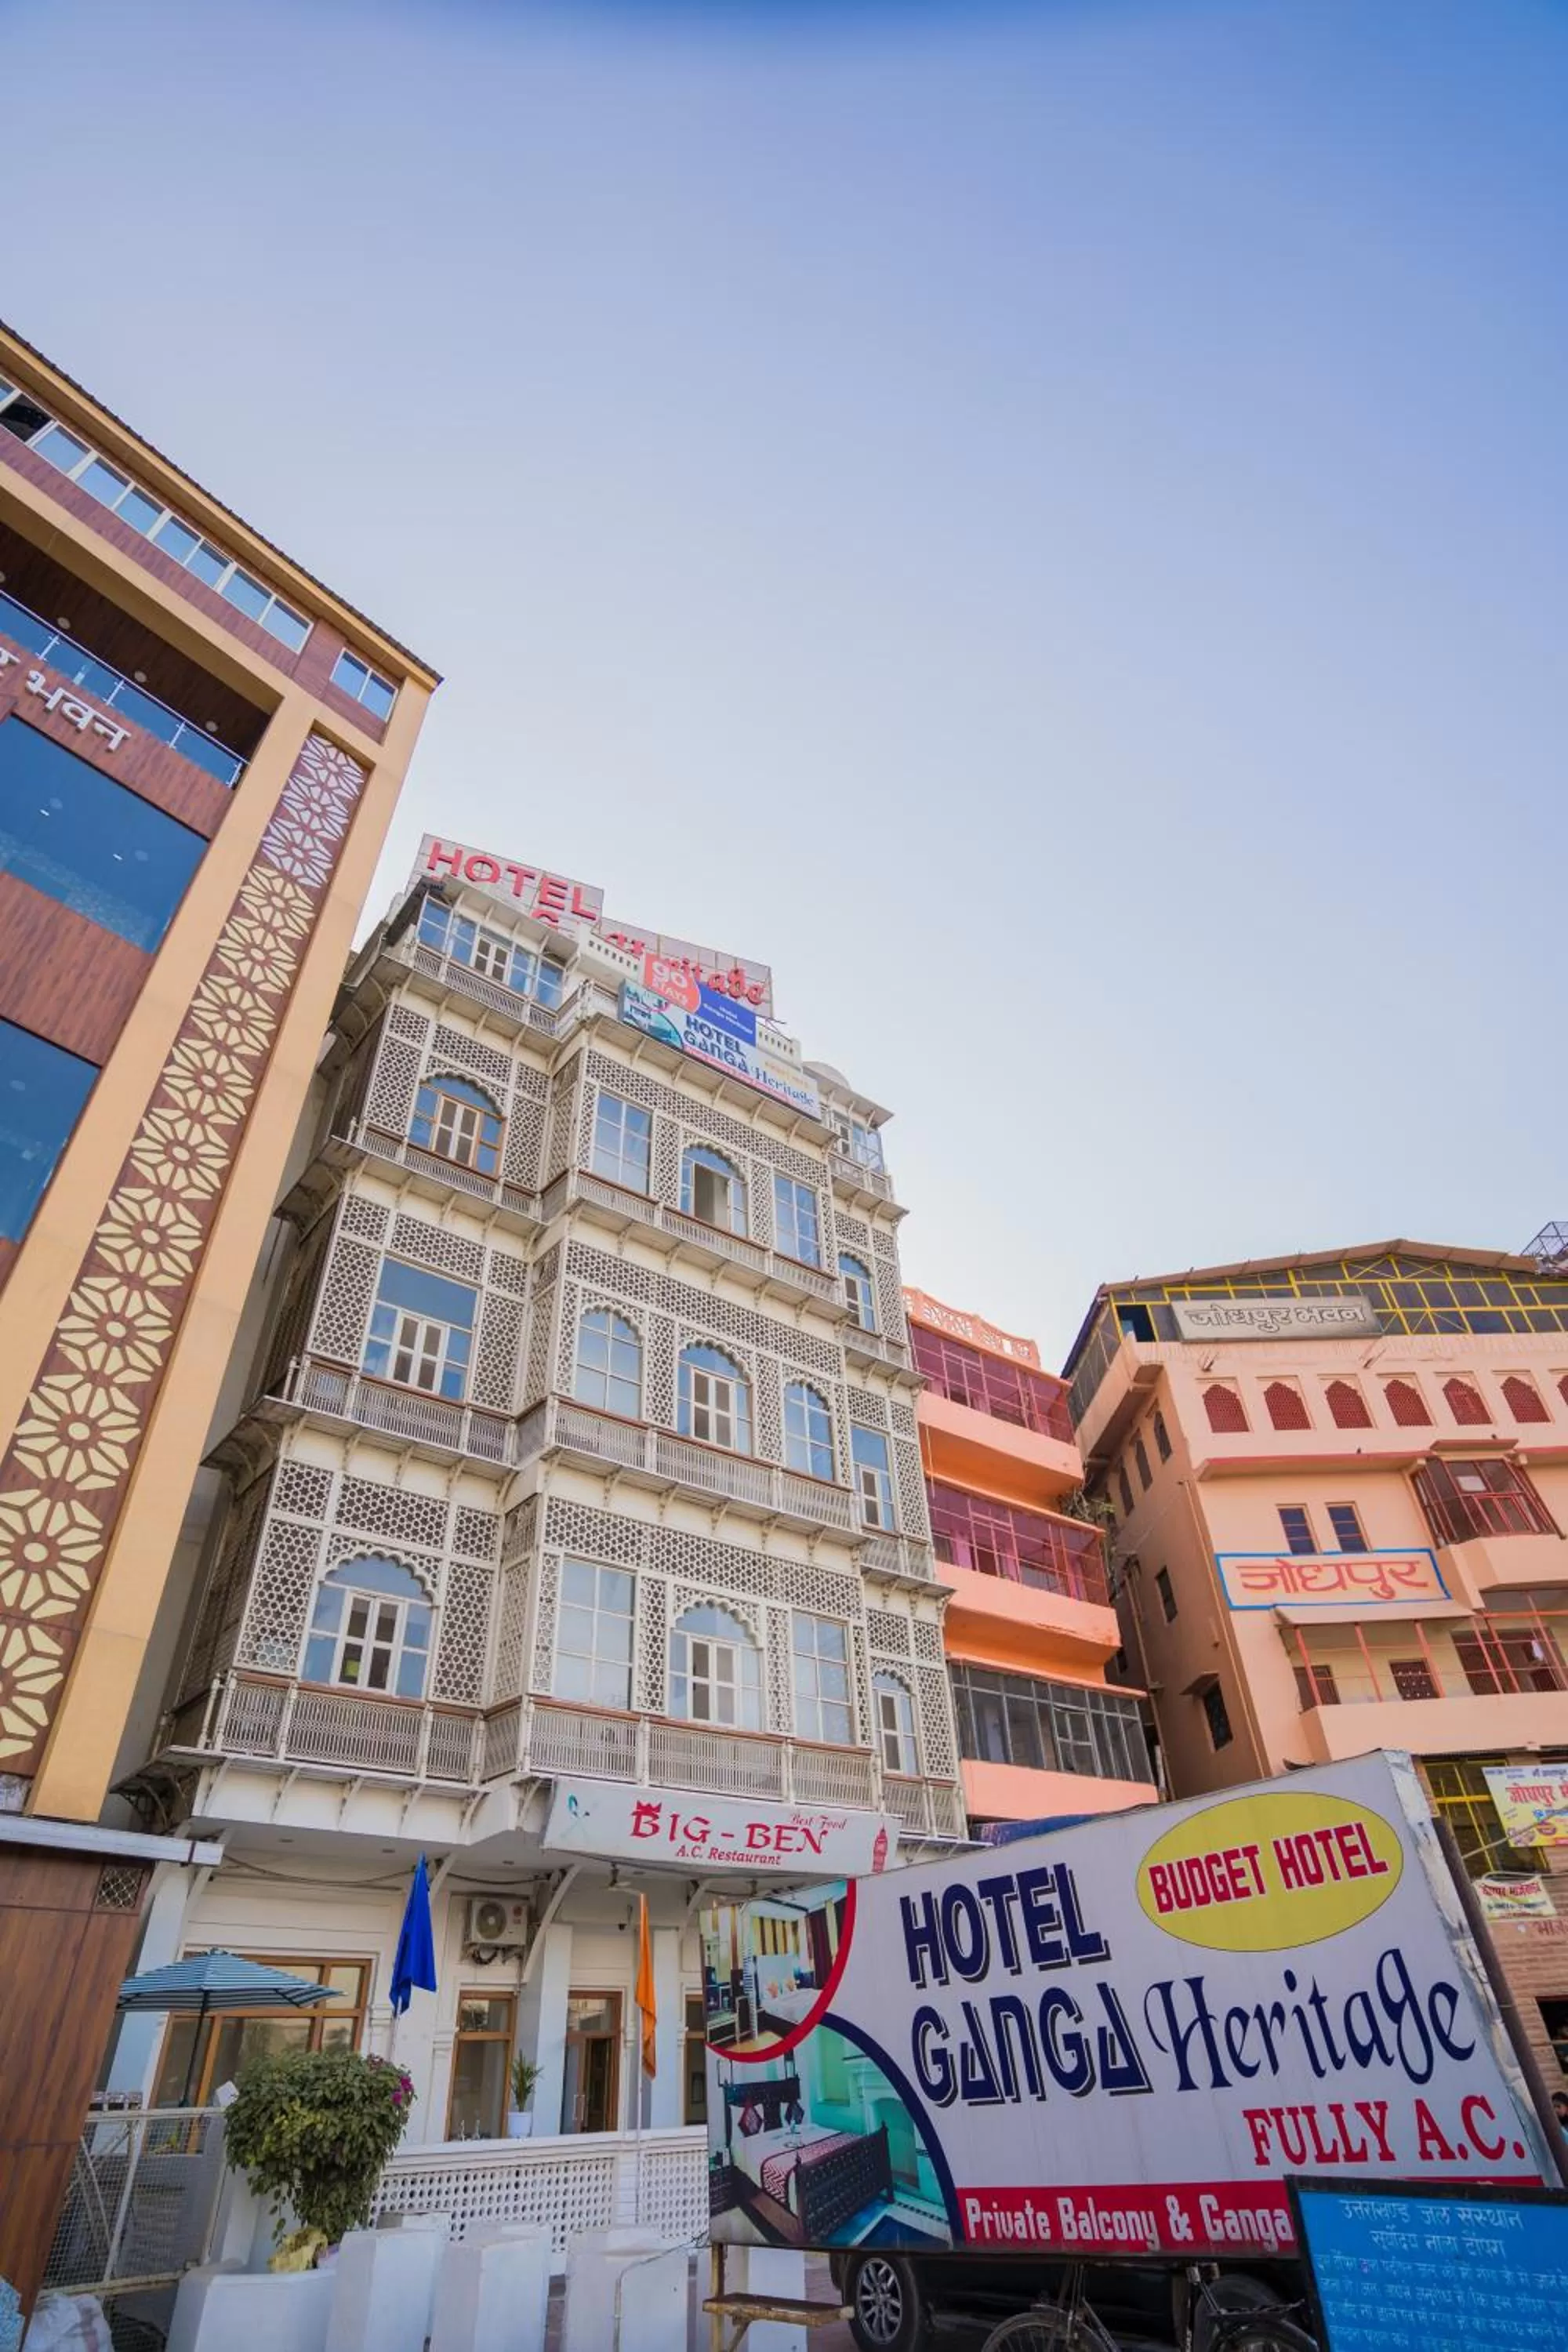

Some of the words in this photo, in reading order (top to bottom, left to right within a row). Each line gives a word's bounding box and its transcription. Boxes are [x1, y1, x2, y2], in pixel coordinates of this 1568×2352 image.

[26, 670, 132, 752] भवन
[427, 841, 597, 921] HOTEL
[684, 1030, 750, 1075] GANGA
[685, 1014, 746, 1057] HOTEL
[1184, 1303, 1293, 1333] जोधपुर
[1294, 1303, 1367, 1324] भवन
[1236, 1558, 1428, 1599] जोधपुर
[790, 1813, 813, 1826] Best
[817, 1815, 848, 1830] Food
[676, 1844, 704, 1859] A.C.
[707, 1846, 782, 1866] Restaurant
[1149, 1844, 1267, 1915] BUDGET
[1276, 1821, 1388, 1891] HOTEL
[900, 1863, 1111, 1988] HOTEL
[912, 1982, 1154, 2107] GANGA
[1145, 1948, 1476, 2092] Heritage
[1243, 2100, 1397, 2167] FULLY
[1417, 2095, 1526, 2162] A.C.
[965, 2198, 1051, 2244] Private
[1060, 2195, 1161, 2252] Balcony
[1167, 2199, 1195, 2242] &
[1199, 2194, 1294, 2252] Ganga
[1416, 2205, 1450, 2226] जल
